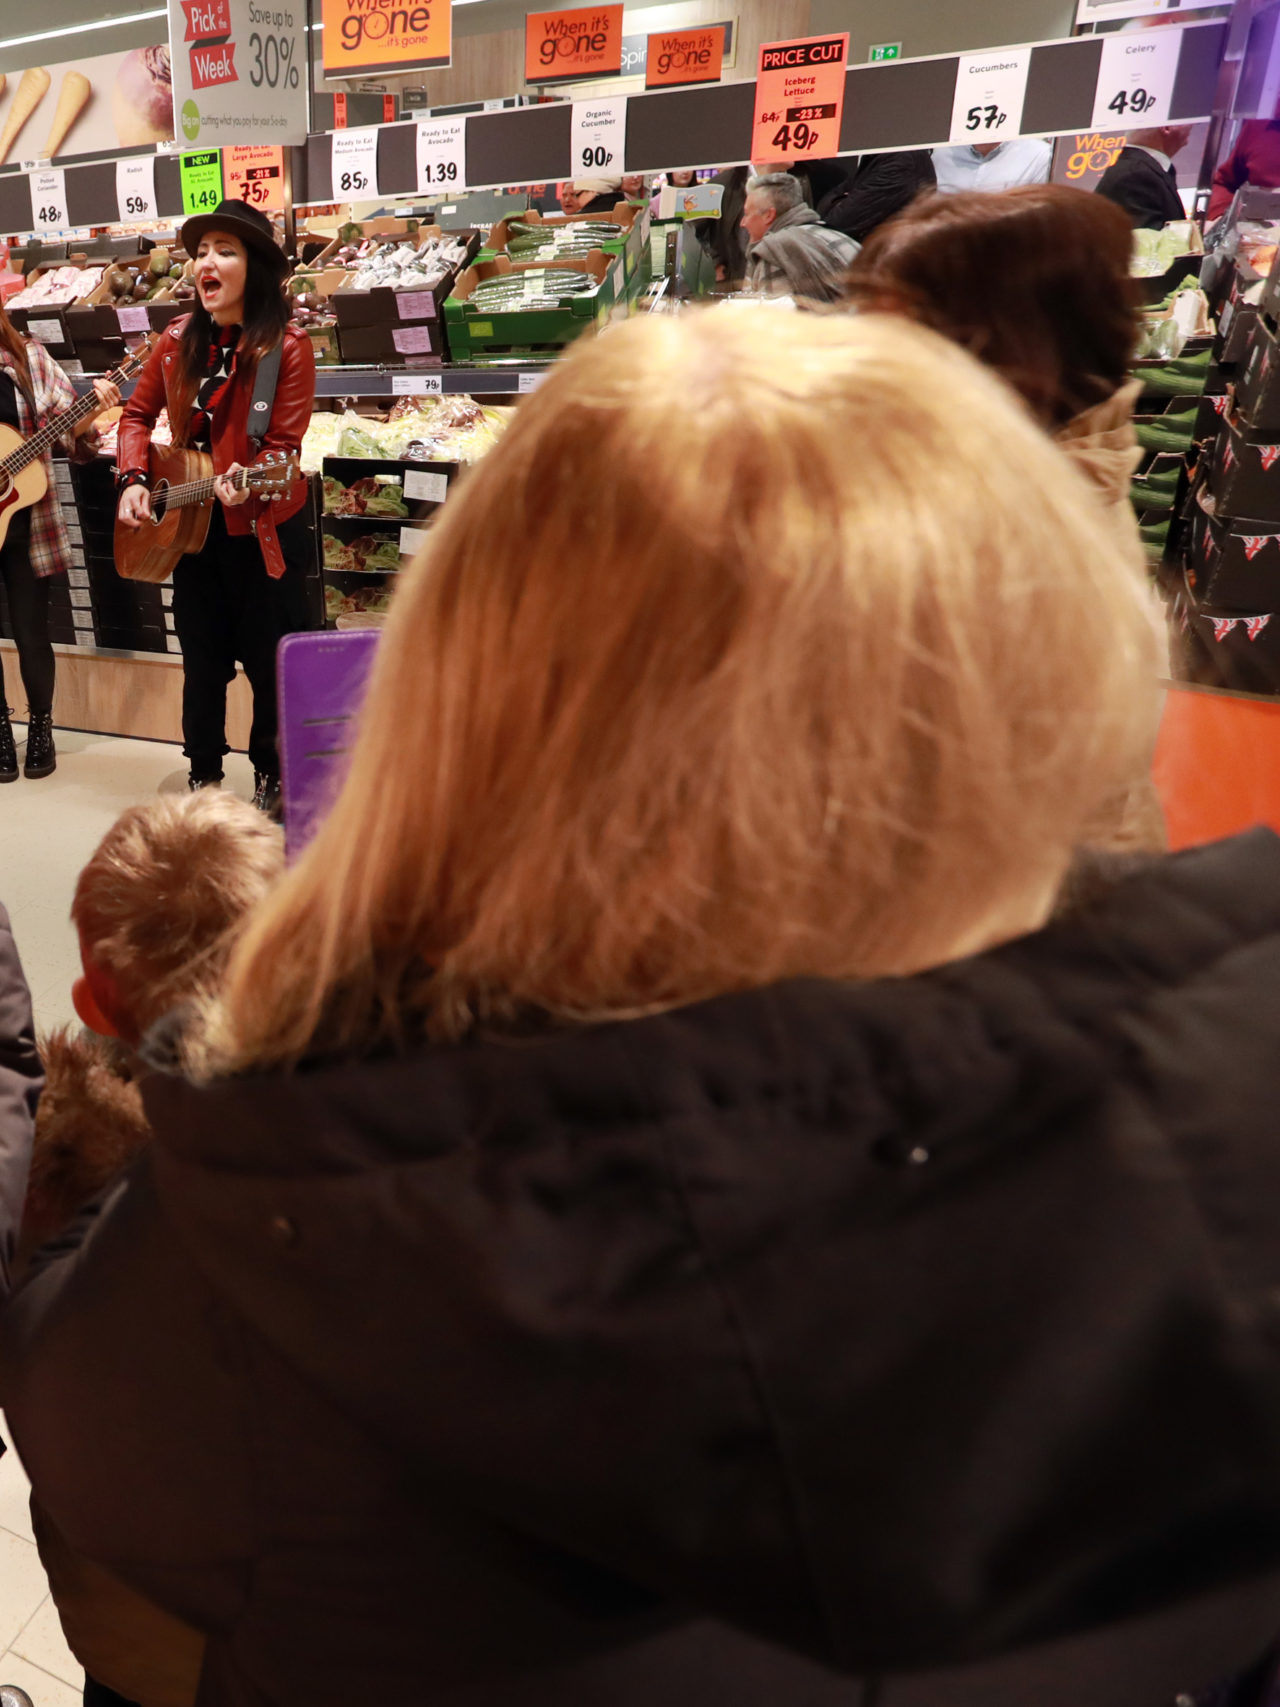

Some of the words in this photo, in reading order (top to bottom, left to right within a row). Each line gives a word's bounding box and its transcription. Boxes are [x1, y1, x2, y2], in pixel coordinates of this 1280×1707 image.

[191, 3, 216, 33] Pick
[249, 1, 271, 24] Save
[272, 11, 283, 32] up
[284, 9, 294, 27] to
[544, 19, 587, 37] When
[591, 14, 610, 32] it's
[341, 7, 430, 51] gone
[401, 35, 428, 48] gone
[540, 32, 607, 65] gone
[662, 37, 696, 53] When
[699, 35, 714, 49] it's
[1125, 44, 1157, 55] Celery
[195, 48, 232, 82] Week
[249, 32, 300, 90] 30%
[657, 50, 711, 74] gone
[764, 48, 806, 68] PRICE
[809, 44, 842, 61] CUT
[969, 61, 1018, 74] Cucumbers
[784, 87, 815, 97] Lettuce
[785, 77, 816, 87] Iceberg
[1108, 88, 1157, 115] 49p
[581, 118, 617, 128] Cucumber
[586, 109, 612, 119] Organic
[966, 105, 1007, 131] 57p
[337, 139, 354, 147] Ready
[363, 136, 373, 144] Eat
[422, 129, 441, 138] Ready
[450, 127, 461, 135] Eat
[428, 136, 455, 146] Avocado
[772, 122, 819, 152] 49p
[1075, 133, 1127, 152] When
[191, 154, 211, 166] NEW
[582, 146, 613, 167] 90p
[341, 171, 369, 191] 85p
[425, 161, 457, 183] 1.39
[191, 189, 218, 209] 1.49
[239, 181, 270, 204] 75p
[39, 205, 62, 223] 48p
[126, 196, 149, 215] 59p
[425, 379, 440, 391] 79p
